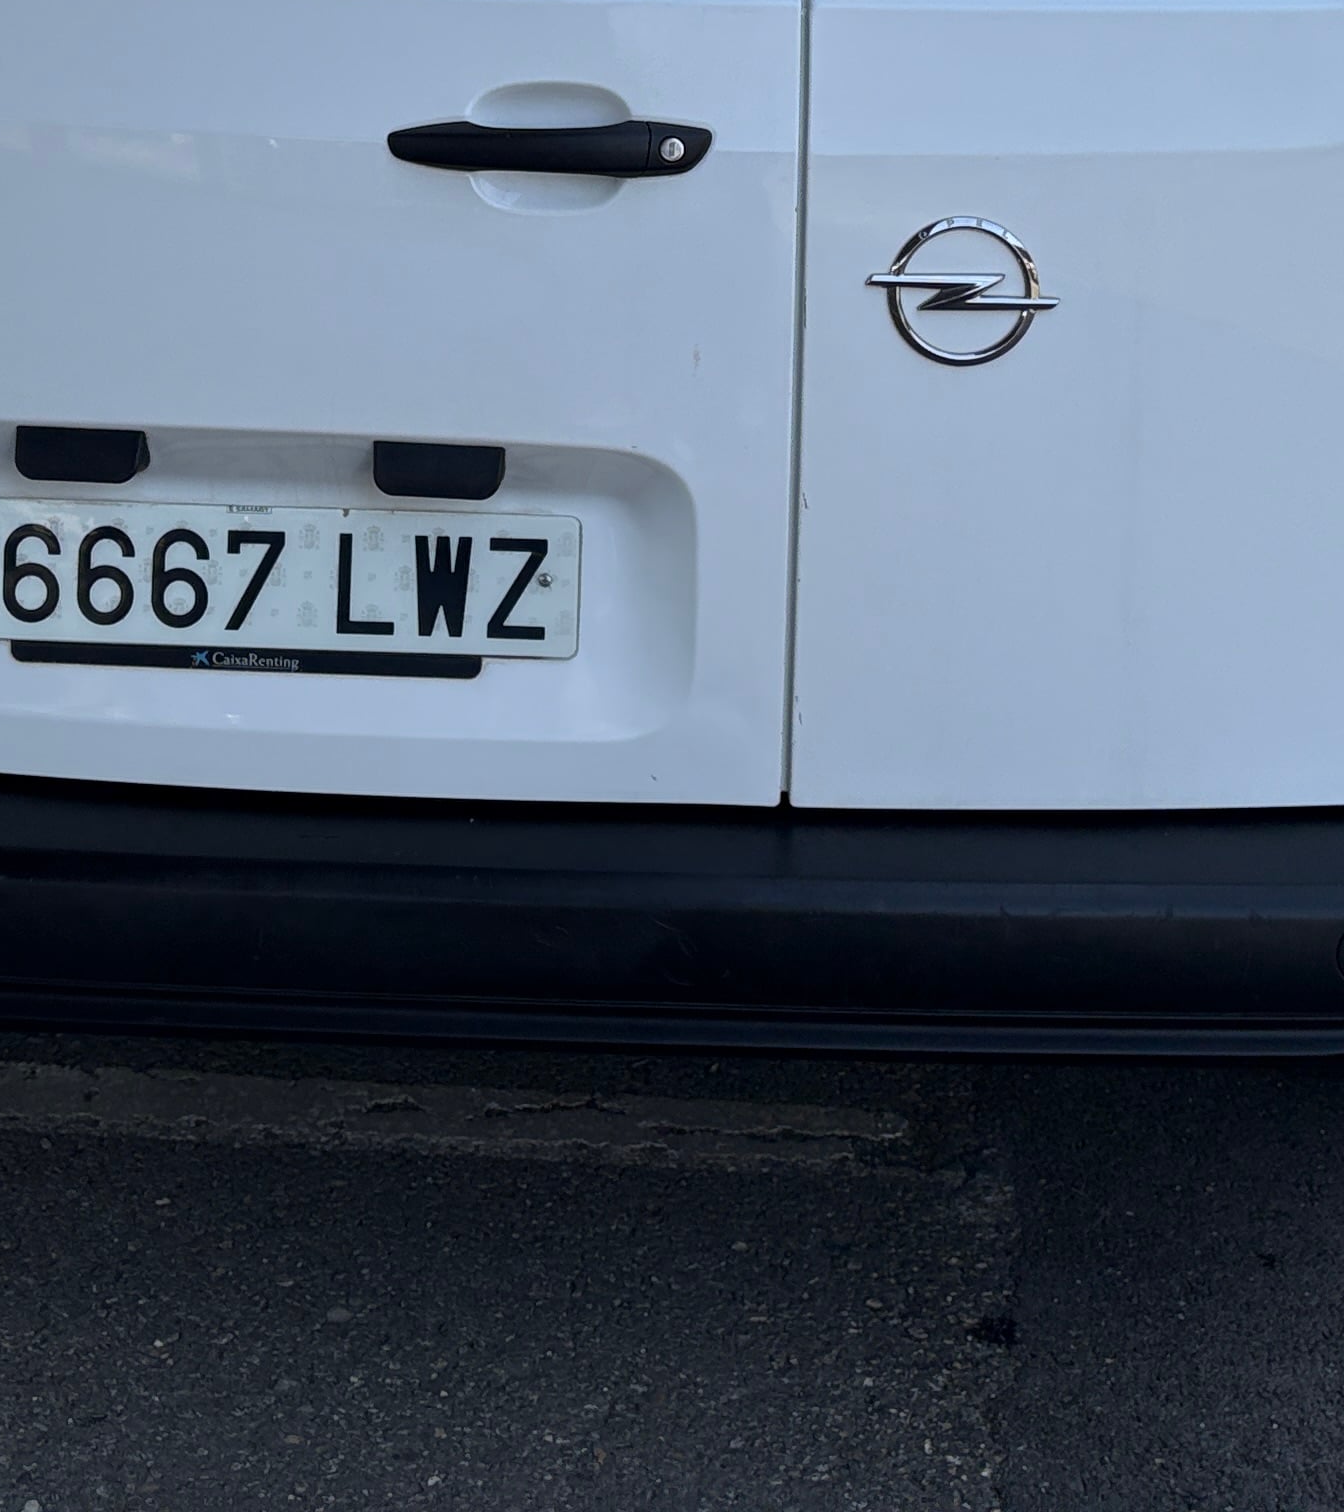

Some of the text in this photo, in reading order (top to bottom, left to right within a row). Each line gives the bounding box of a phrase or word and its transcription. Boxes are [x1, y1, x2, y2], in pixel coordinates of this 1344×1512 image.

[918, 217, 1010, 241] OPEL
[0, 523, 287, 632] 6667
[335, 532, 549, 640] LWZ
[212, 651, 300, 672] CaixaRenting
